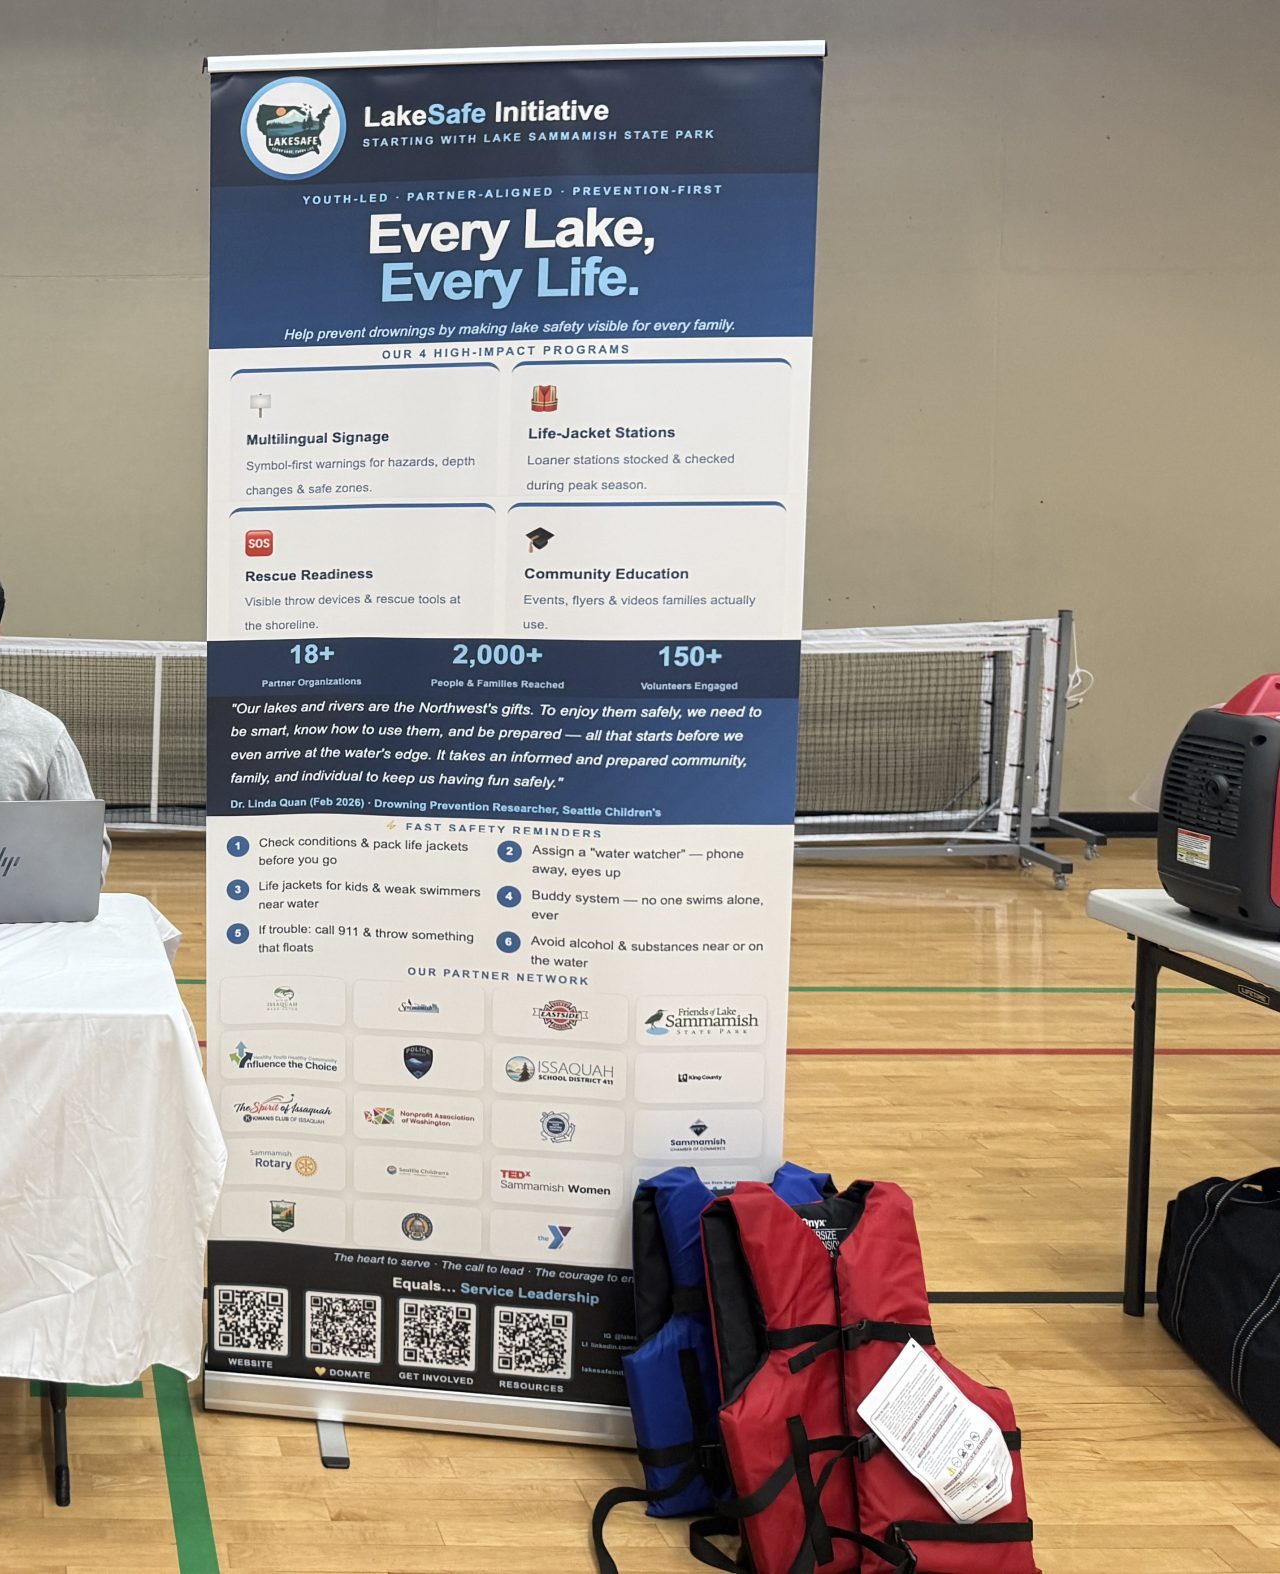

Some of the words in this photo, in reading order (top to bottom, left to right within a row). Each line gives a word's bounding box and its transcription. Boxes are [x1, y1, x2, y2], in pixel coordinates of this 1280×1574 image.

[363, 101, 486, 127] LakeSafe
[494, 99, 609, 122] Initiative
[268, 136, 318, 146] LAKESAFE
[361, 135, 433, 147] STARTING
[439, 133, 476, 144] WITH
[483, 132, 521, 143] LAKE
[527, 130, 616, 141] SAMMAMISH
[623, 129, 668, 140] STATE
[675, 129, 713, 139] PARK
[302, 192, 387, 205] YOUTH-LED
[406, 186, 552, 201] PARTNER-ALIGNED
[571, 184, 722, 196] PREVENTION-FIRST
[369, 212, 511, 261] Every
[524, 206, 655, 255] Lake,
[381, 261, 523, 308] Every
[536, 255, 638, 297] Life.
[381, 348, 411, 359] OUR
[418, 348, 426, 358] 4
[433, 345, 535, 358] HIGH-IMPACT
[542, 343, 628, 355] PROGRAMS
[246, 431, 328, 447] Multilingual
[331, 431, 389, 446] Signage
[528, 426, 611, 439] Life-Jacket
[614, 426, 675, 438] Stations
[245, 459, 313, 473] Symbol-first
[315, 457, 366, 471] warnings
[368, 457, 385, 468] for
[387, 456, 438, 467] hazards,
[441, 455, 475, 468] depth
[527, 454, 570, 465] Loaner
[573, 454, 620, 465] stations
[622, 453, 669, 464] stocked
[672, 453, 681, 464] &
[684, 453, 735, 464] checked
[245, 485, 293, 497] changes
[296, 483, 305, 494] &
[308, 483, 332, 494] safe
[334, 483, 372, 493] zones.
[525, 479, 564, 493] during
[567, 479, 598, 493] peak
[600, 481, 647, 490] season.
[248, 538, 270, 549] SOS
[245, 570, 296, 582] Rescue
[300, 568, 373, 580] Readiness
[524, 567, 611, 582] Community
[615, 567, 688, 579] Education
[289, 643, 334, 664] 18+
[451, 643, 542, 668] 2,000+
[658, 645, 722, 667] 150+
[261, 679, 296, 687] Partner
[297, 677, 362, 688] Organizations
[430, 678, 464, 688] People
[466, 678, 474, 687] &
[476, 678, 518, 688] Families
[520, 679, 565, 689] Reached
[639, 681, 692, 690] Volunteers
[693, 681, 738, 692] Engaged
[230, 771, 270, 785] family,
[274, 769, 299, 783] and
[301, 769, 363, 783] individual
[365, 770, 379, 782] to
[381, 771, 415, 786] keep
[418, 774, 435, 784] us
[438, 772, 484, 788] having
[487, 773, 509, 786] fun
[512, 775, 564, 790] safely."
[405, 821, 441, 831] FAST
[448, 823, 505, 833] SAFETY
[512, 825, 601, 838] REMINDERS
[235, 842, 240, 850] 1
[258, 836, 295, 848] Check
[297, 835, 357, 847] conditions
[360, 837, 369, 848] &
[372, 839, 401, 851] pack
[404, 839, 422, 850] life
[424, 839, 468, 853] jackets
[258, 854, 295, 866] before
[297, 856, 319, 866] you
[321, 856, 337, 867] go
[407, 966, 436, 976] OUR
[442, 968, 509, 981] PARTNER
[516, 972, 588, 986] NETWORK
[679, 1008, 708, 1016] Friends
[717, 1008, 737, 1016] Lake
[666, 1015, 759, 1028] Sammamish
[288, 1060, 303, 1069] the
[305, 1061, 337, 1072] Choice
[538, 1061, 614, 1078] ISSAQUAH
[569, 1076, 601, 1084] DISTRICT
[234, 1103, 251, 1112] The
[250, 1102, 279, 1113] Spirit
[280, 1105, 290, 1114] of
[291, 1103, 332, 1115] Issaquah
[400, 1110, 433, 1119] Nonprofit
[435, 1113, 475, 1121] Association
[410, 1118, 451, 1127] Washington
[671, 1138, 726, 1146] Sammamish
[255, 1158, 292, 1170] Rotary
[501, 1180, 565, 1193] Sammamish
[568, 1185, 611, 1195] Women
[816, 1231, 837, 1240] RSIZE
[392, 1276, 455, 1292] Equals...
[459, 1281, 513, 1297] Service
[517, 1286, 599, 1306] Leadership
[228, 1357, 273, 1369] WEBSITE
[329, 1368, 370, 1379] DONATE
[398, 1371, 419, 1380] GET
[421, 1373, 474, 1385] INVOLVED
[498, 1379, 563, 1393] RESOURCES
